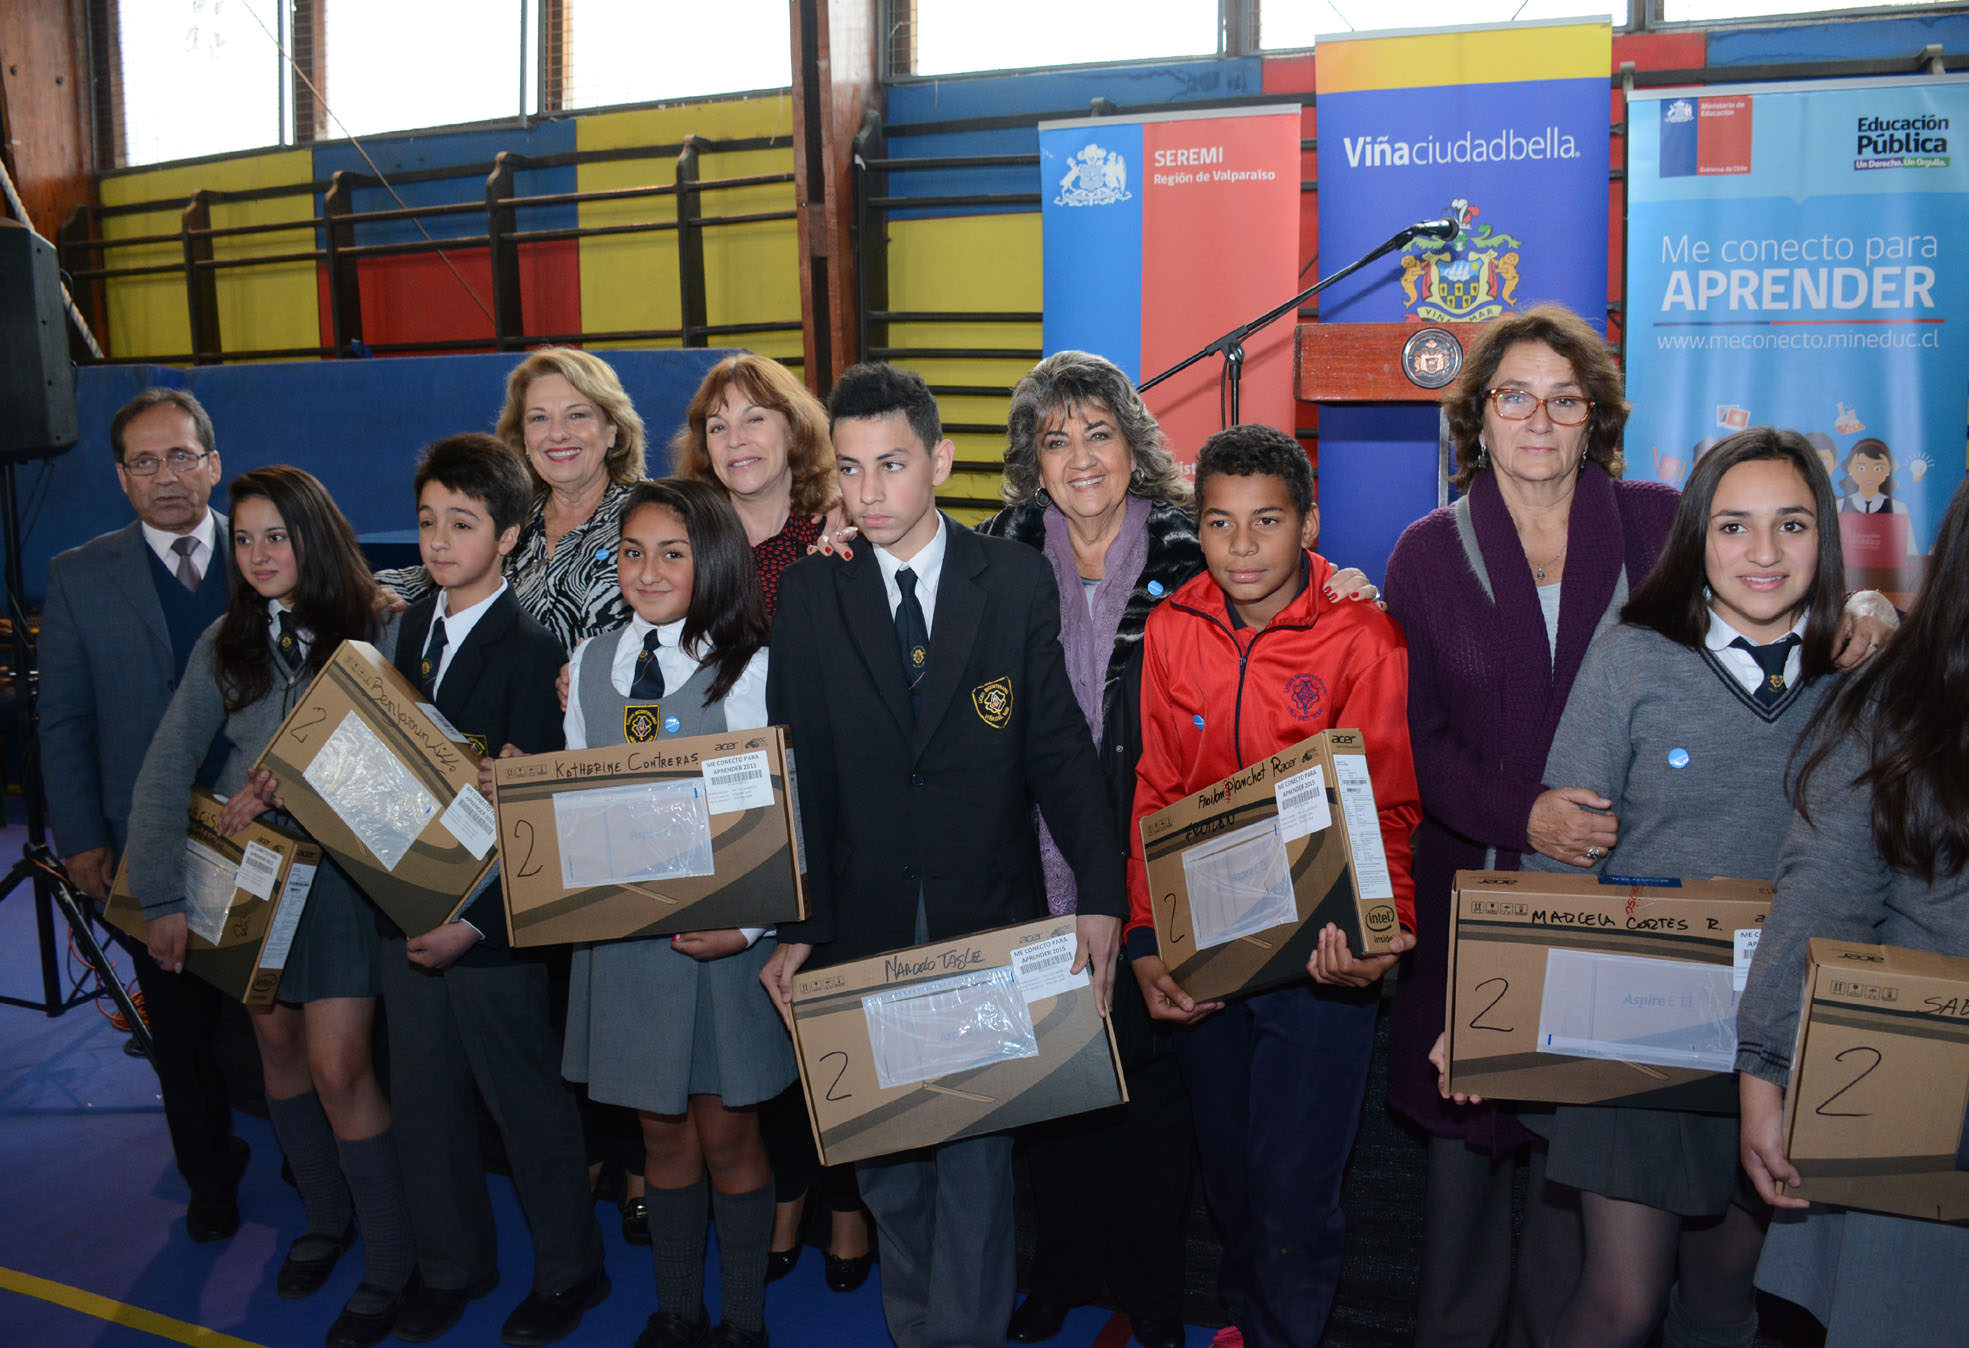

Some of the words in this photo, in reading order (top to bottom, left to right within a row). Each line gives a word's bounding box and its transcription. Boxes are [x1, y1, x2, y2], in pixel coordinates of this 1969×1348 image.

[1858, 115, 1949, 132] Educación
[1858, 132, 1948, 155] Pública
[1154, 146, 1223, 167] SEREMI
[1154, 172, 1193, 186] Región
[1196, 170, 1210, 182] de
[1213, 168, 1276, 182] Valparaíso
[1661, 234, 1710, 264] Me
[1721, 234, 1854, 262] conecto
[1866, 234, 1938, 267] para
[1660, 266, 1936, 312] APRENDER
[1657, 328, 1940, 350] www.meconecto.mineduc.cl
[290, 706, 327, 743] 2
[714, 741, 738, 751] acer
[1331, 735, 1356, 744] acer
[514, 819, 544, 878] 2
[1164, 892, 1185, 944] 2
[1368, 911, 1392, 924] intel
[1626, 916, 1689, 930] CORTES
[1469, 977, 1514, 1032] 2
[819, 1051, 853, 1102] 2
[1815, 1046, 1882, 1117] 2
